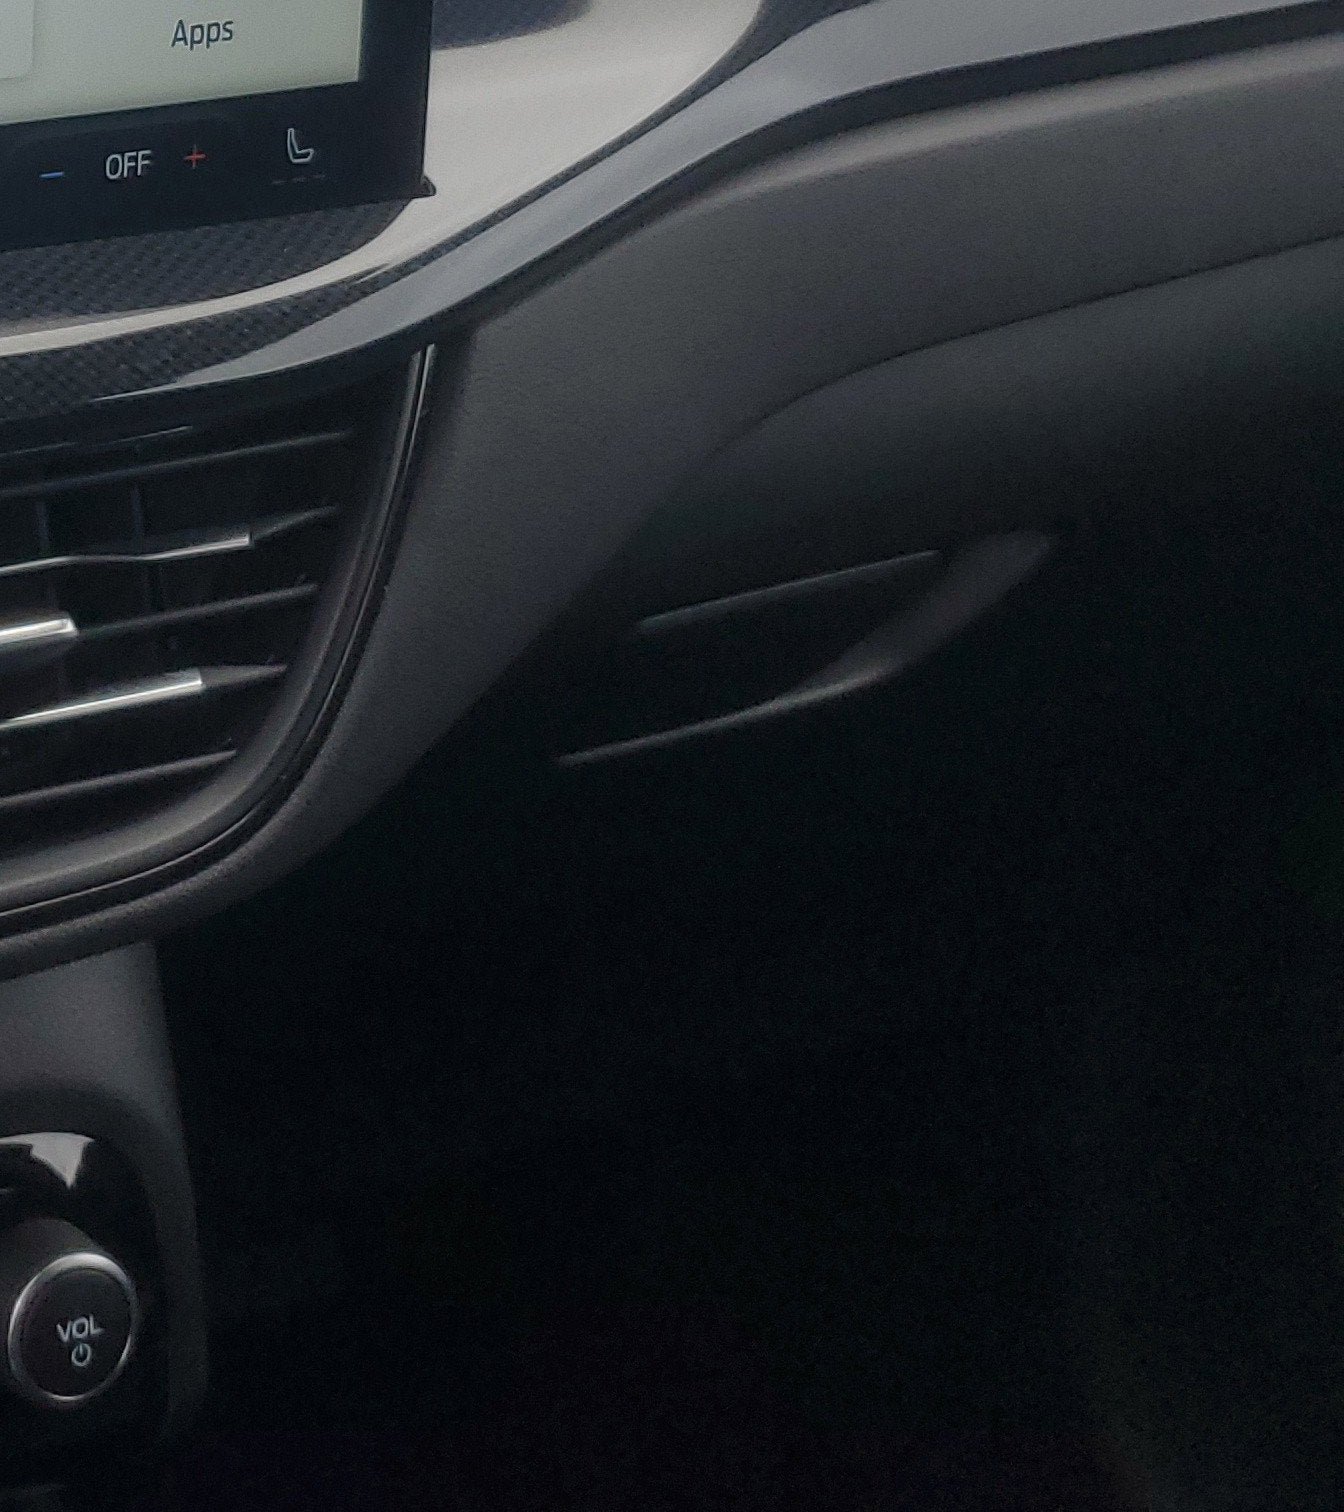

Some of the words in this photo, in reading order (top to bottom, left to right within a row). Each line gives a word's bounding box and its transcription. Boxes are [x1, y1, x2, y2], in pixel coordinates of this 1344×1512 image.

[171, 19, 234, 51] Apps
[105, 149, 152, 180] OFF
[56, 1315, 102, 1342] VOL
